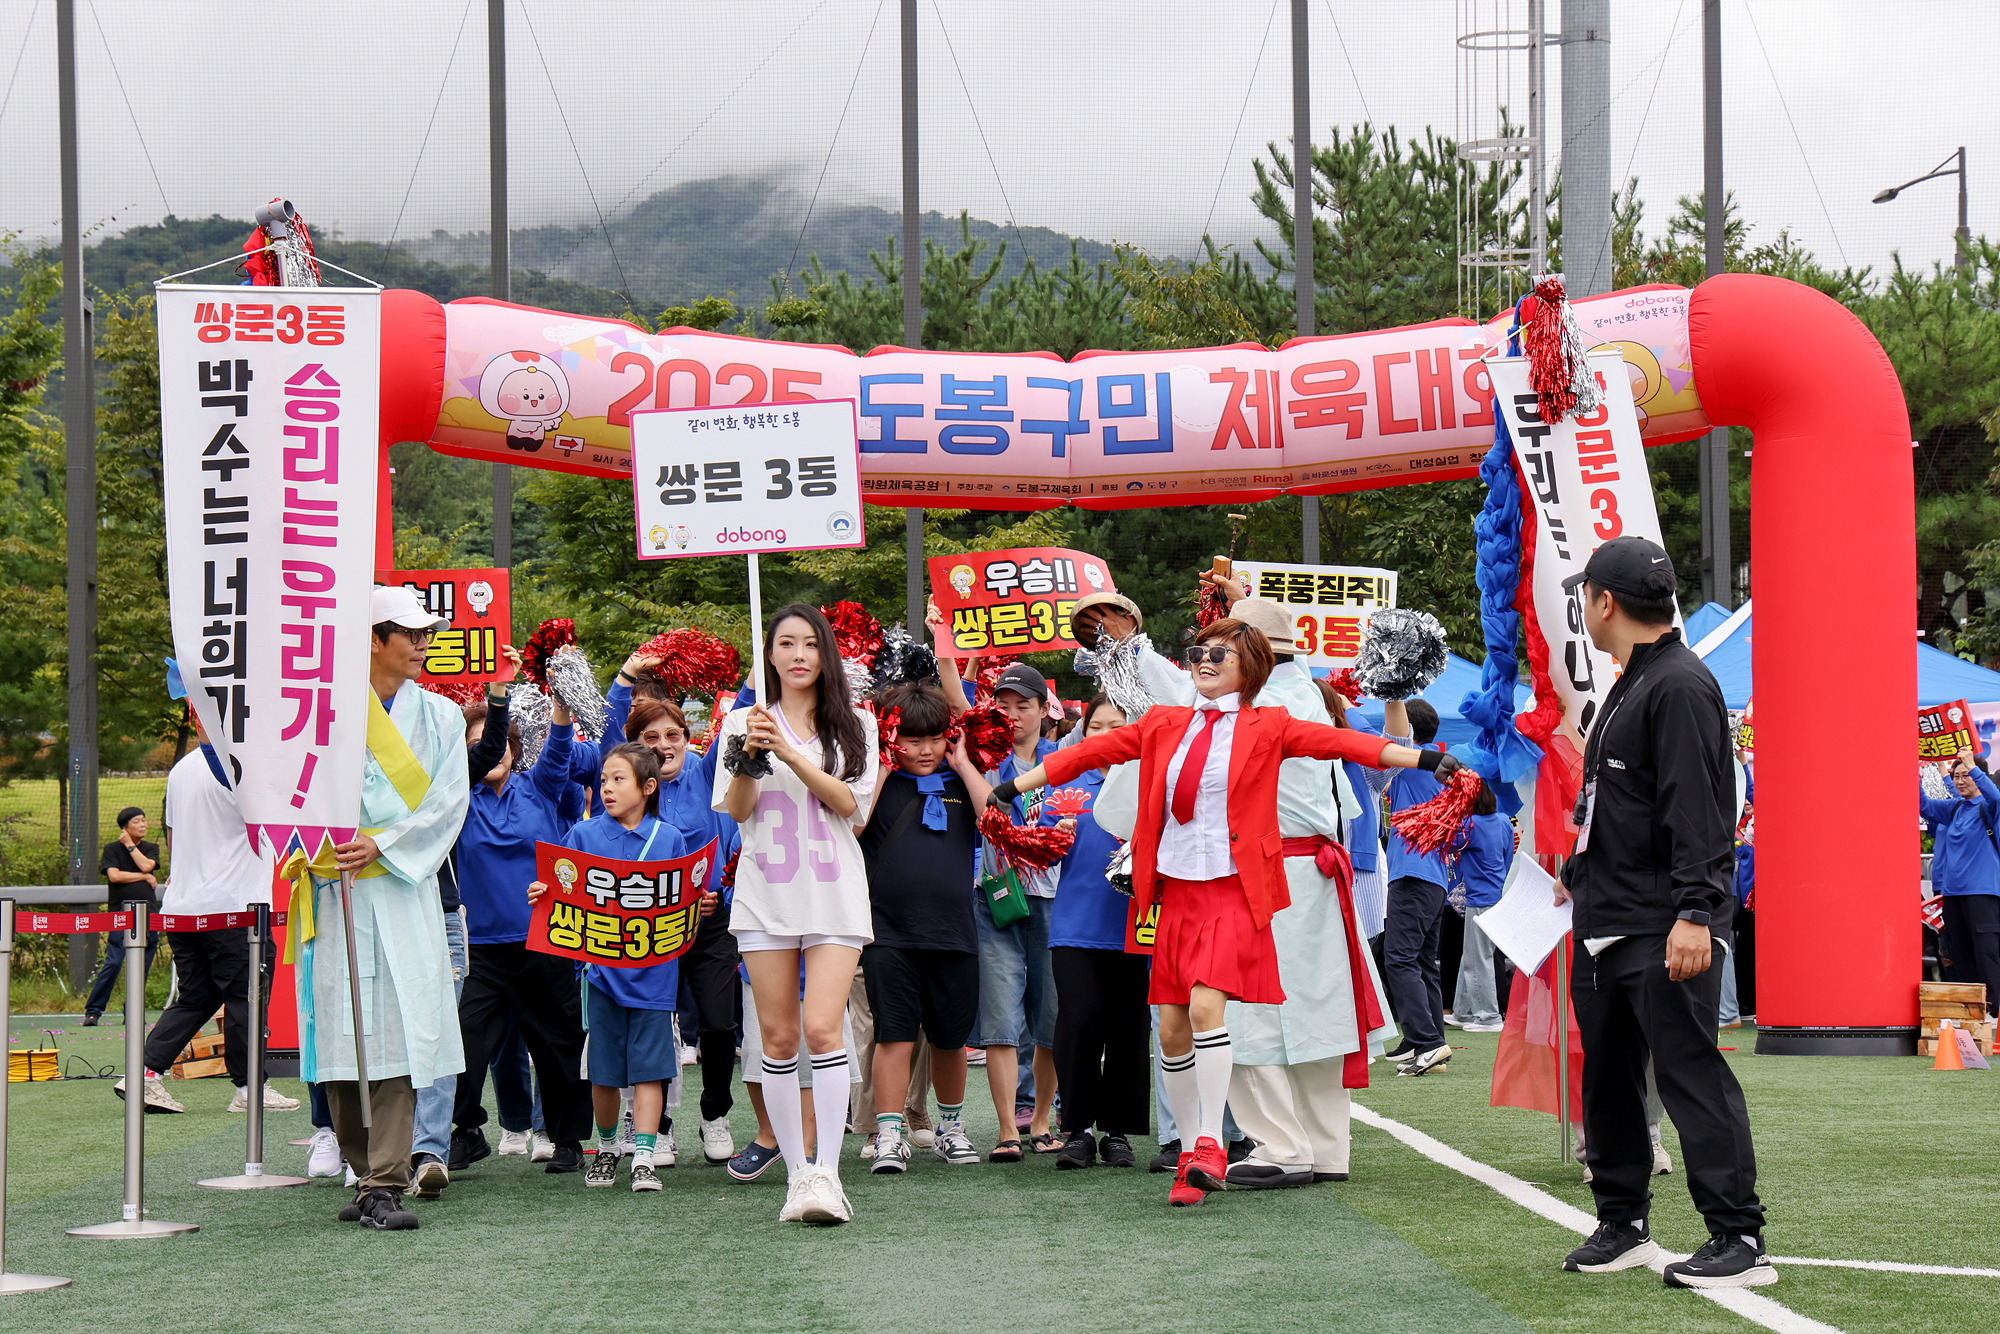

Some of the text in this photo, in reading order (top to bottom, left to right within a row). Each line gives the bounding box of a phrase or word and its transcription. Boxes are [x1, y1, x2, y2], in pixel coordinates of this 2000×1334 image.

[1594, 318, 1612, 328] 같이
[1639, 306, 1669, 319] 행복한
[1625, 297, 1683, 308] dobong
[194, 302, 345, 346] 쌍문3동
[859, 344, 1499, 458] 도봉구민 체육대회
[688, 411, 800, 433] 같이 변화, 행복한 도봉
[198, 358, 254, 545] 박수는
[592, 454, 614, 465] 일시
[1366, 463, 1392, 471] KRA
[1409, 455, 1460, 470] 대성실업
[656, 456, 837, 506] 쌍문 3동
[860, 479, 940, 492] 락원체육공원
[1015, 483, 1082, 495] 도봉구체육회
[1253, 472, 1294, 483] Rinnai
[716, 526, 786, 544] dobong
[281, 363, 341, 809] 승리는 우리가!
[985, 558, 1077, 597] 우승!!
[1259, 570, 1391, 608] 폭풍질주!!
[1296, 615, 1372, 658] 3동
[754, 790, 841, 884] 35
[586, 867, 682, 909] 우승!!
[549, 896, 702, 958] 쌍문3동!!
